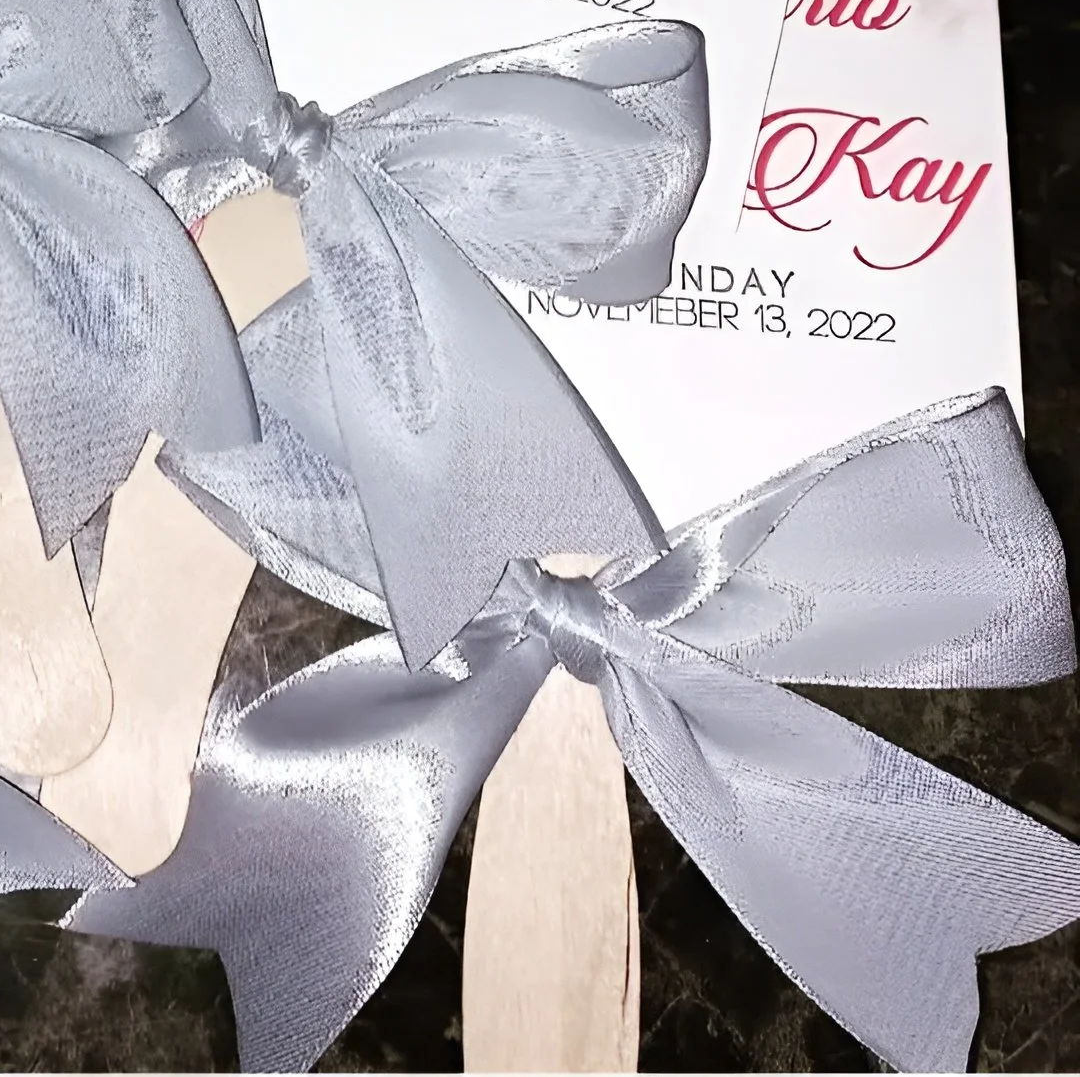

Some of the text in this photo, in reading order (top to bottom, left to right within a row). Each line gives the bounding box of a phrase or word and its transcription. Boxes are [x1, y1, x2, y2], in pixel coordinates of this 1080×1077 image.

[742, 107, 993, 271] Kay
[681, 263, 795, 298] NDAY
[754, 304, 792, 338] 13,
[807, 308, 896, 343] 2022
